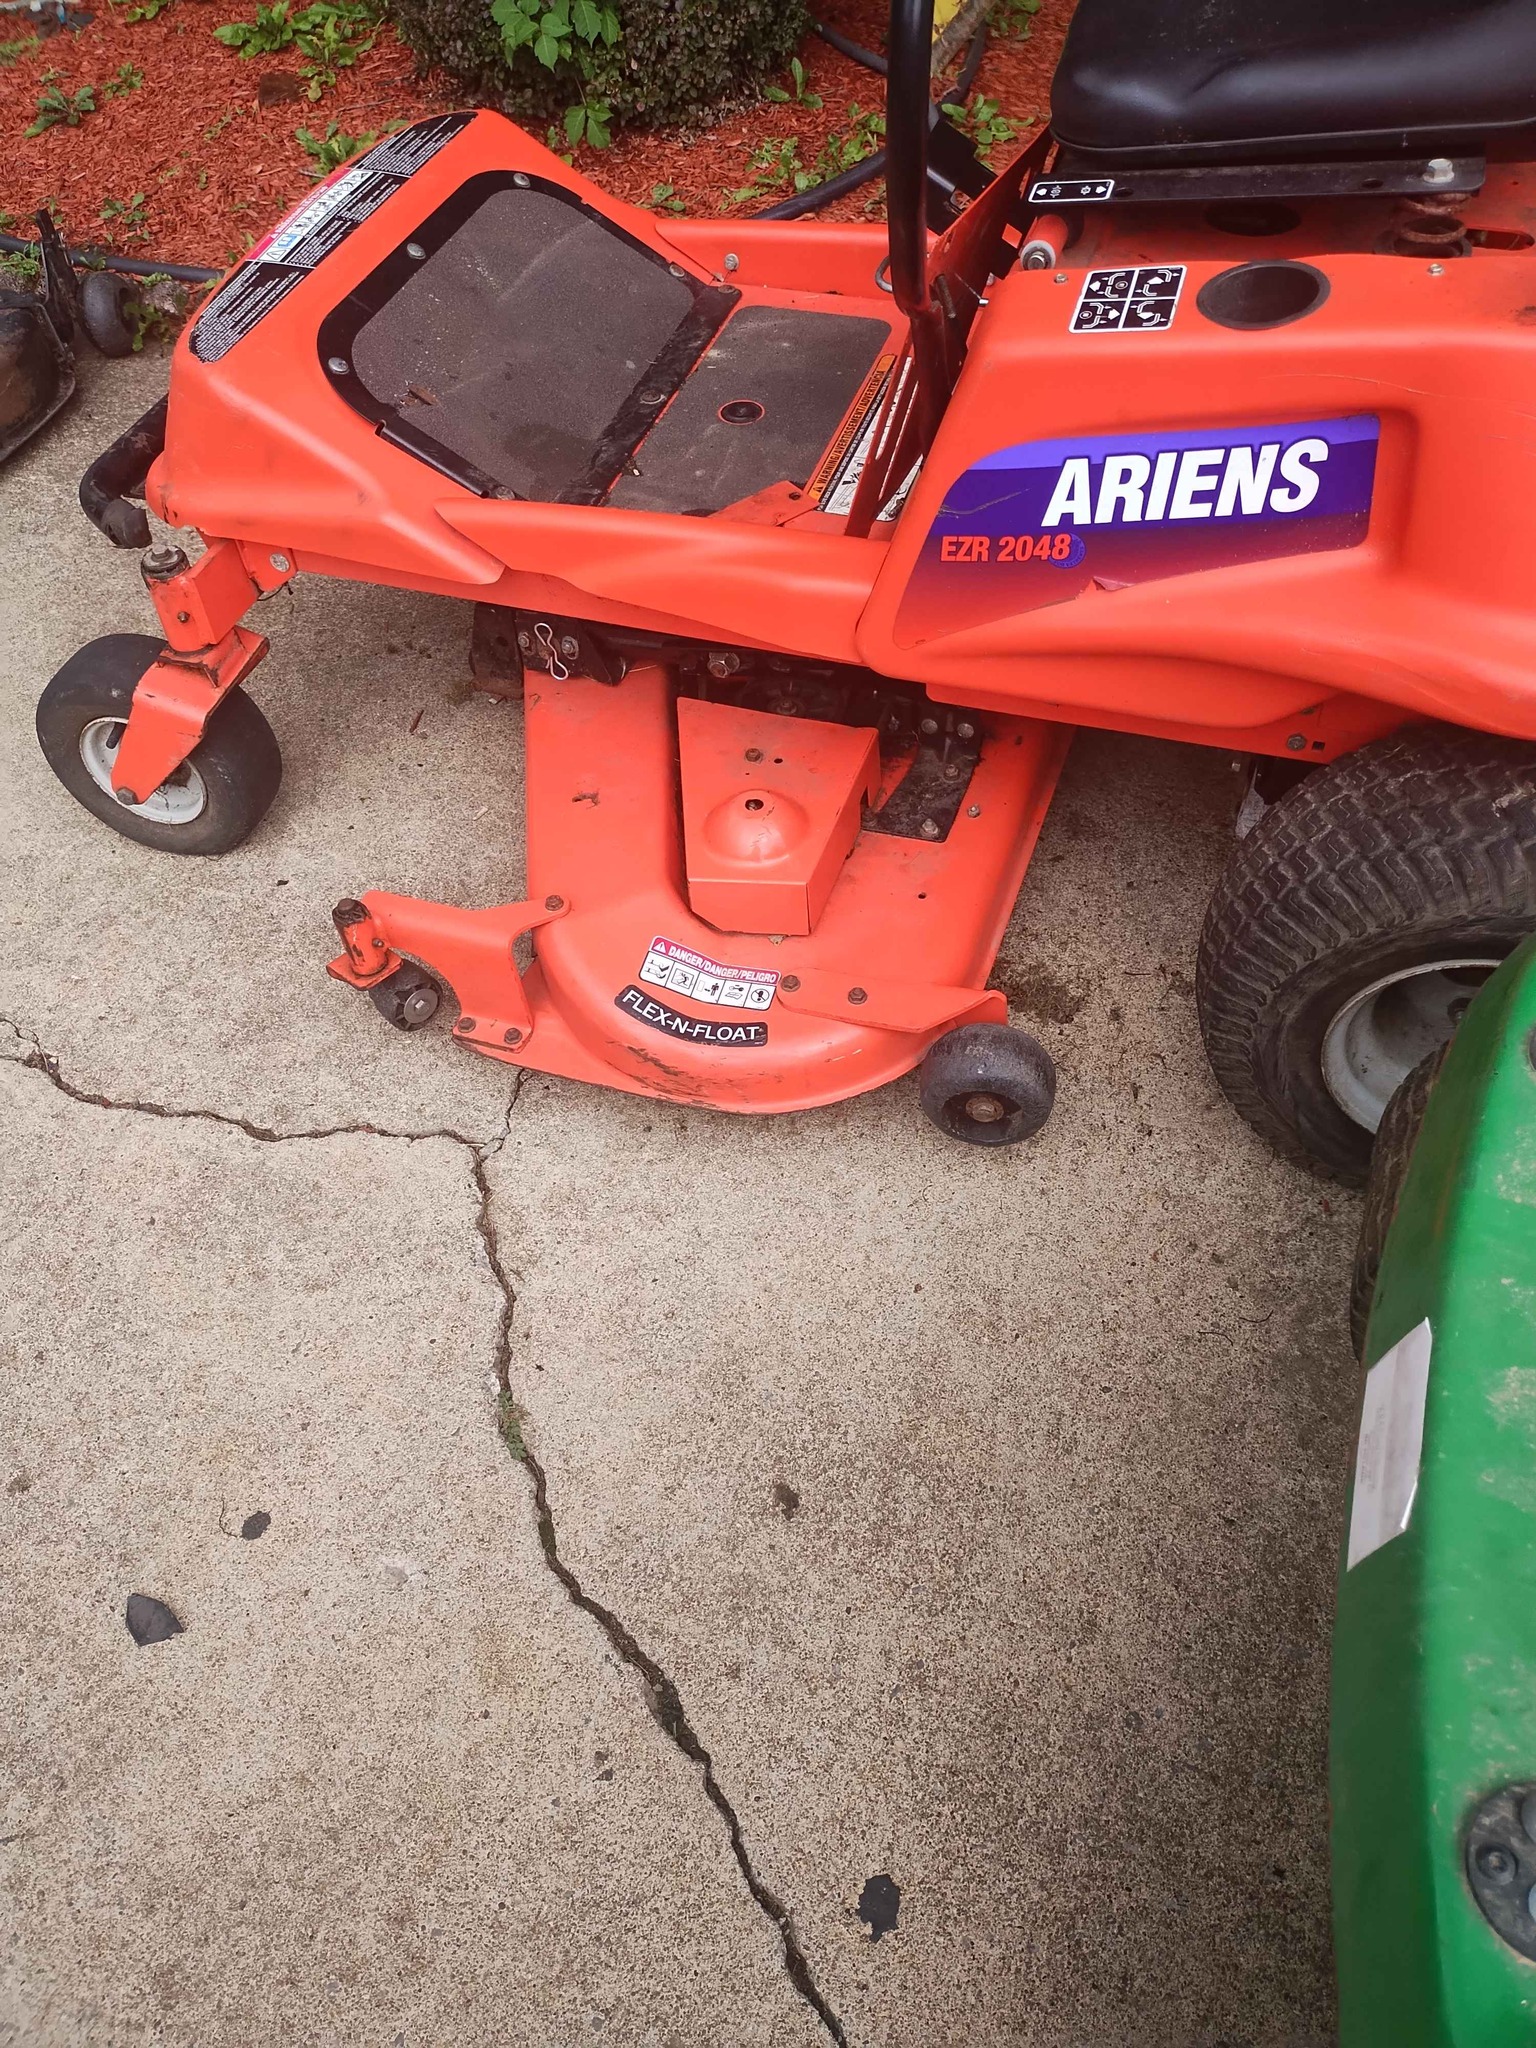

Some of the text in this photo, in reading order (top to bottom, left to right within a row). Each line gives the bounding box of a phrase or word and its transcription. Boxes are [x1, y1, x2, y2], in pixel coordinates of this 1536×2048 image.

[1041, 438, 1329, 527] ARIENS
[941, 536, 989, 562] EZR
[996, 534, 1072, 561] 2048
[668, 945, 777, 983] DANGER/DANGER/PELIGRO
[622, 989, 760, 1041] FLEX-N-FLOAT
